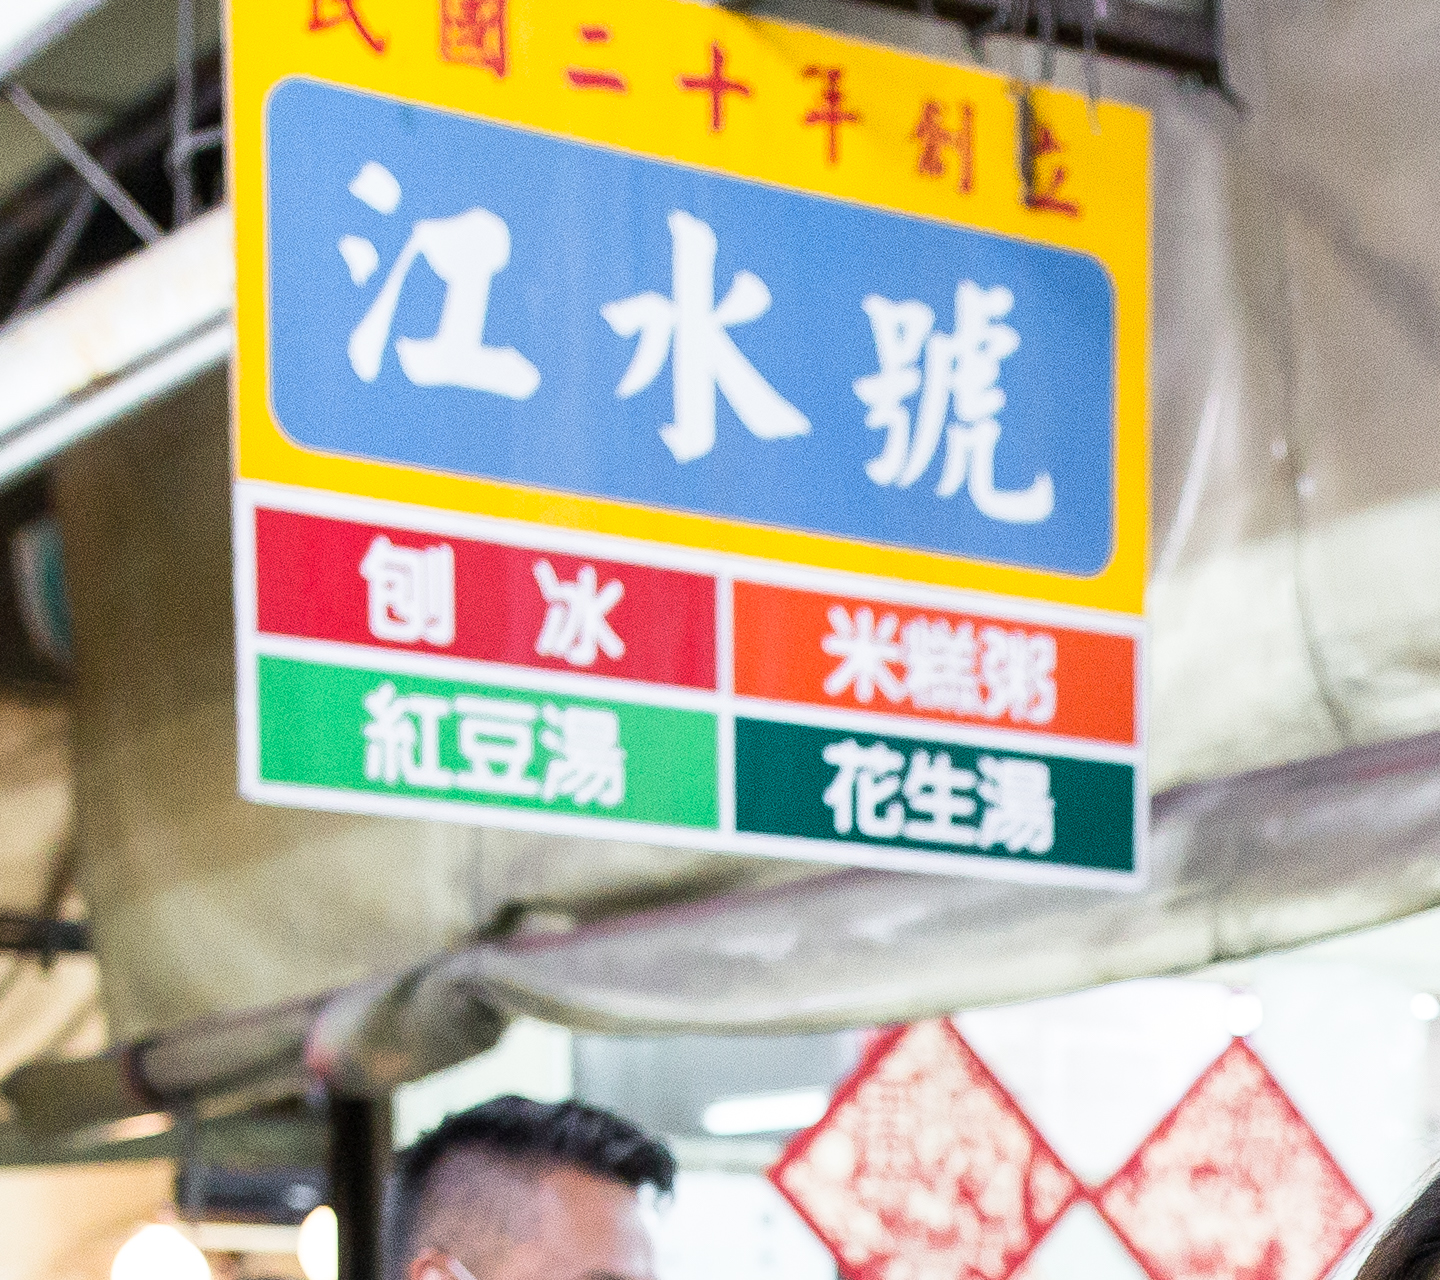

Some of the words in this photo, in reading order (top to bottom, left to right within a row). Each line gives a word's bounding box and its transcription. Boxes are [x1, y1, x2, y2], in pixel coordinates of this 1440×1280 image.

[339, 161, 1054, 524] 江水號
[820, 605, 1057, 724] 米糕粥
[363, 683, 626, 807] 紅豆湯
[822, 738, 1056, 854] 花生湯
